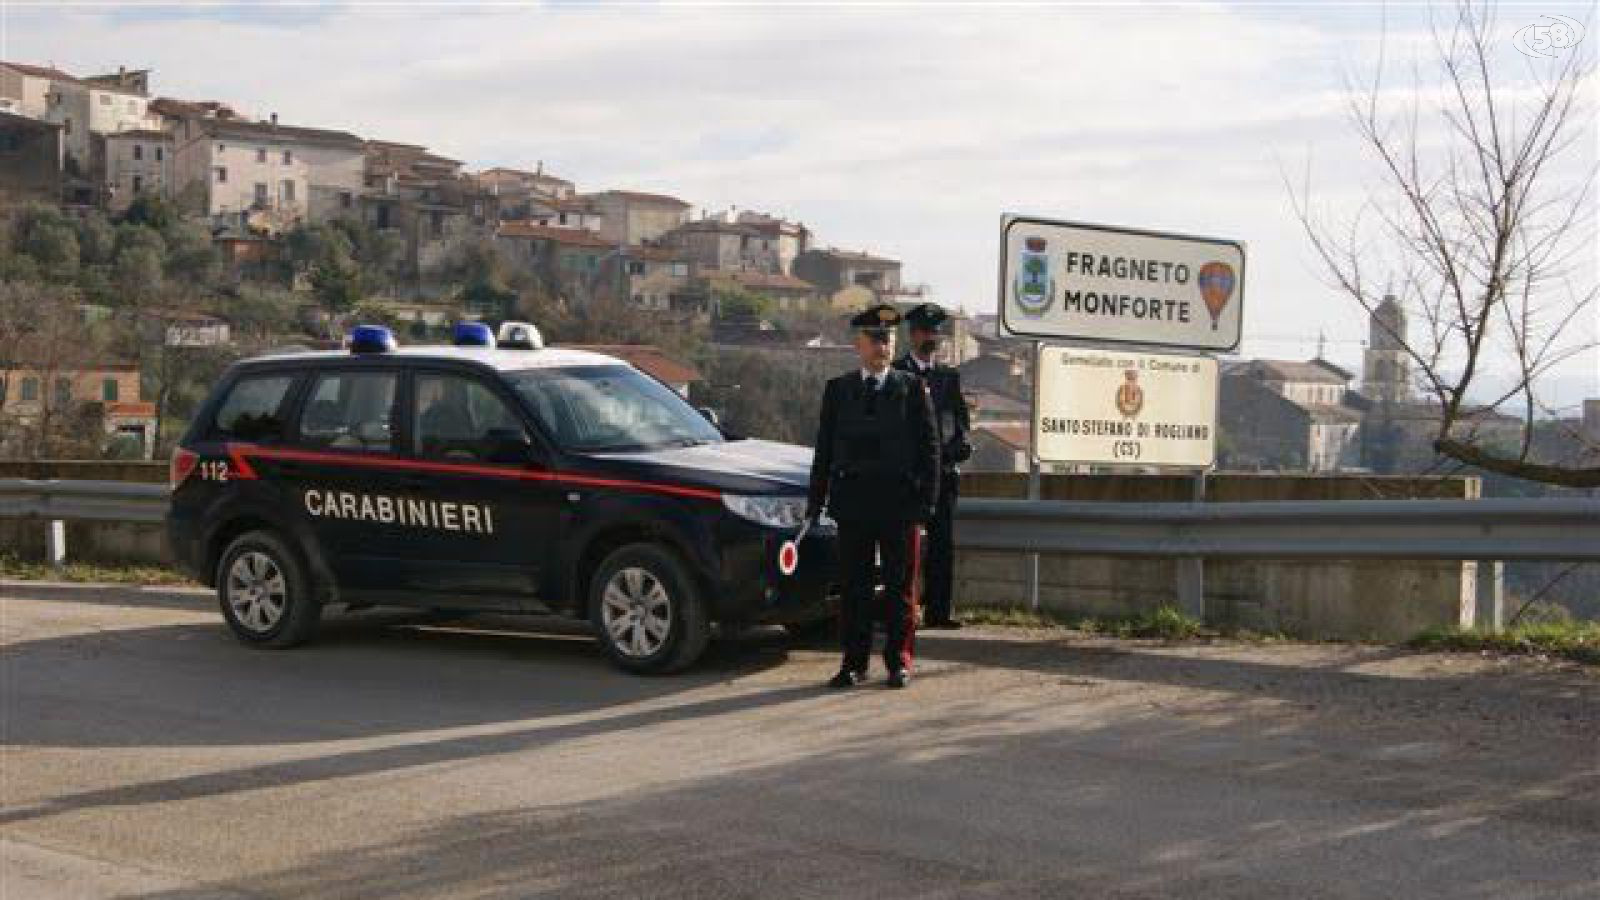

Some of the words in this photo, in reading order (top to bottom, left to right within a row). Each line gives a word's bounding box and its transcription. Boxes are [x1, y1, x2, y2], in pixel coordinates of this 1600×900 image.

[1066, 251, 1190, 285] FRAGNETO
[1063, 289, 1190, 323] MONFORTE
[1041, 416, 1080, 435] SANTO
[1082, 418, 1132, 437] STEFANO
[1137, 420, 1150, 438] DI
[1154, 423, 1209, 441] ROGLIANO
[1113, 440, 1141, 459] (CS)
[200, 461, 229, 481] 112
[304, 488, 494, 535] CARABINIERI
